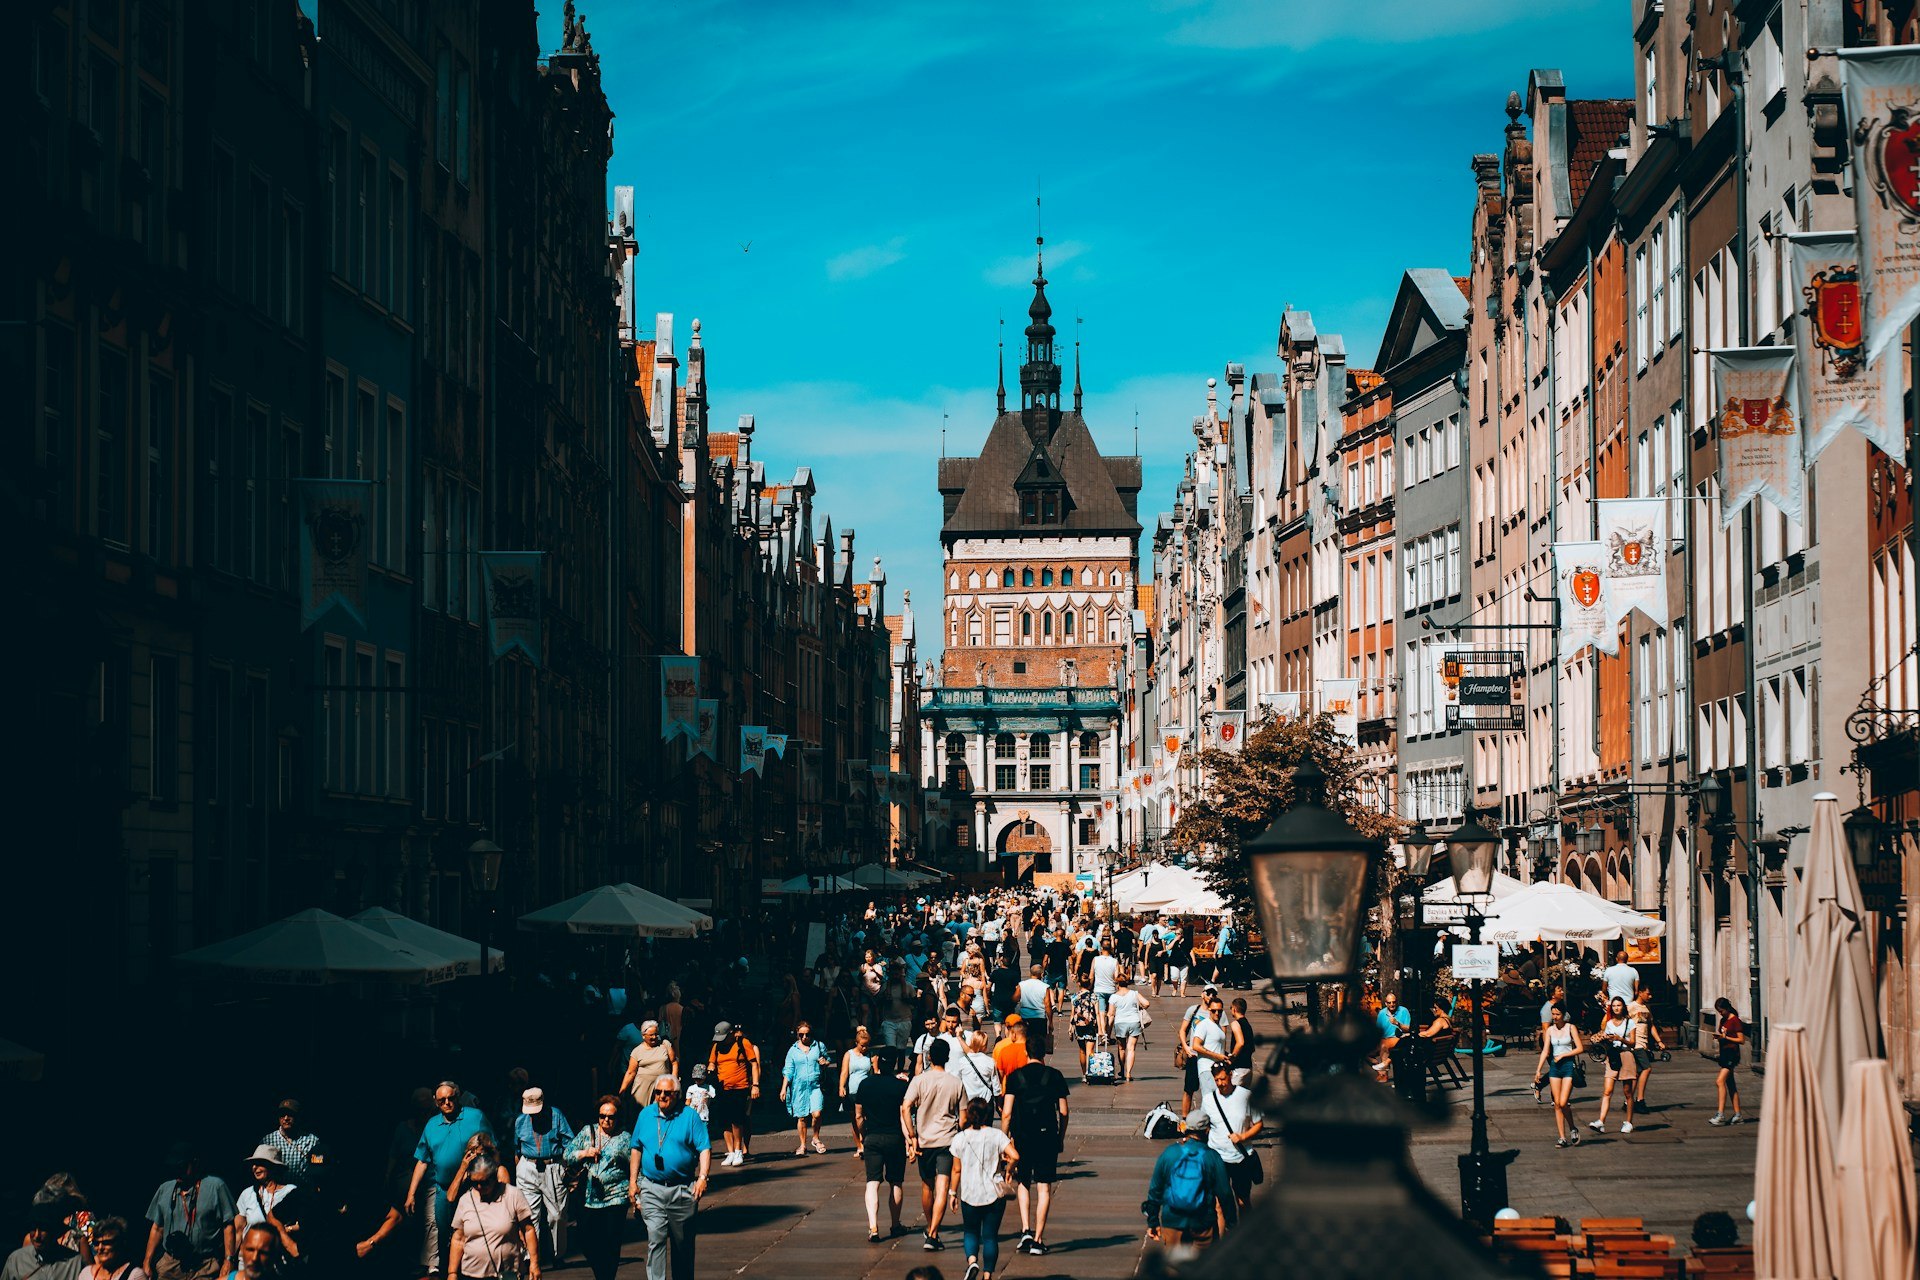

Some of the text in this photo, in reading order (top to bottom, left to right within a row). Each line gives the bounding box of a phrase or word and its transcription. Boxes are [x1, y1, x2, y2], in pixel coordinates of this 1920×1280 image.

[1463, 683, 1507, 695] Hampton
[1858, 859, 1898, 884] ANGE
[1493, 930, 1518, 940] Coca-Cola
[1565, 929, 1594, 939] Coca-Cola
